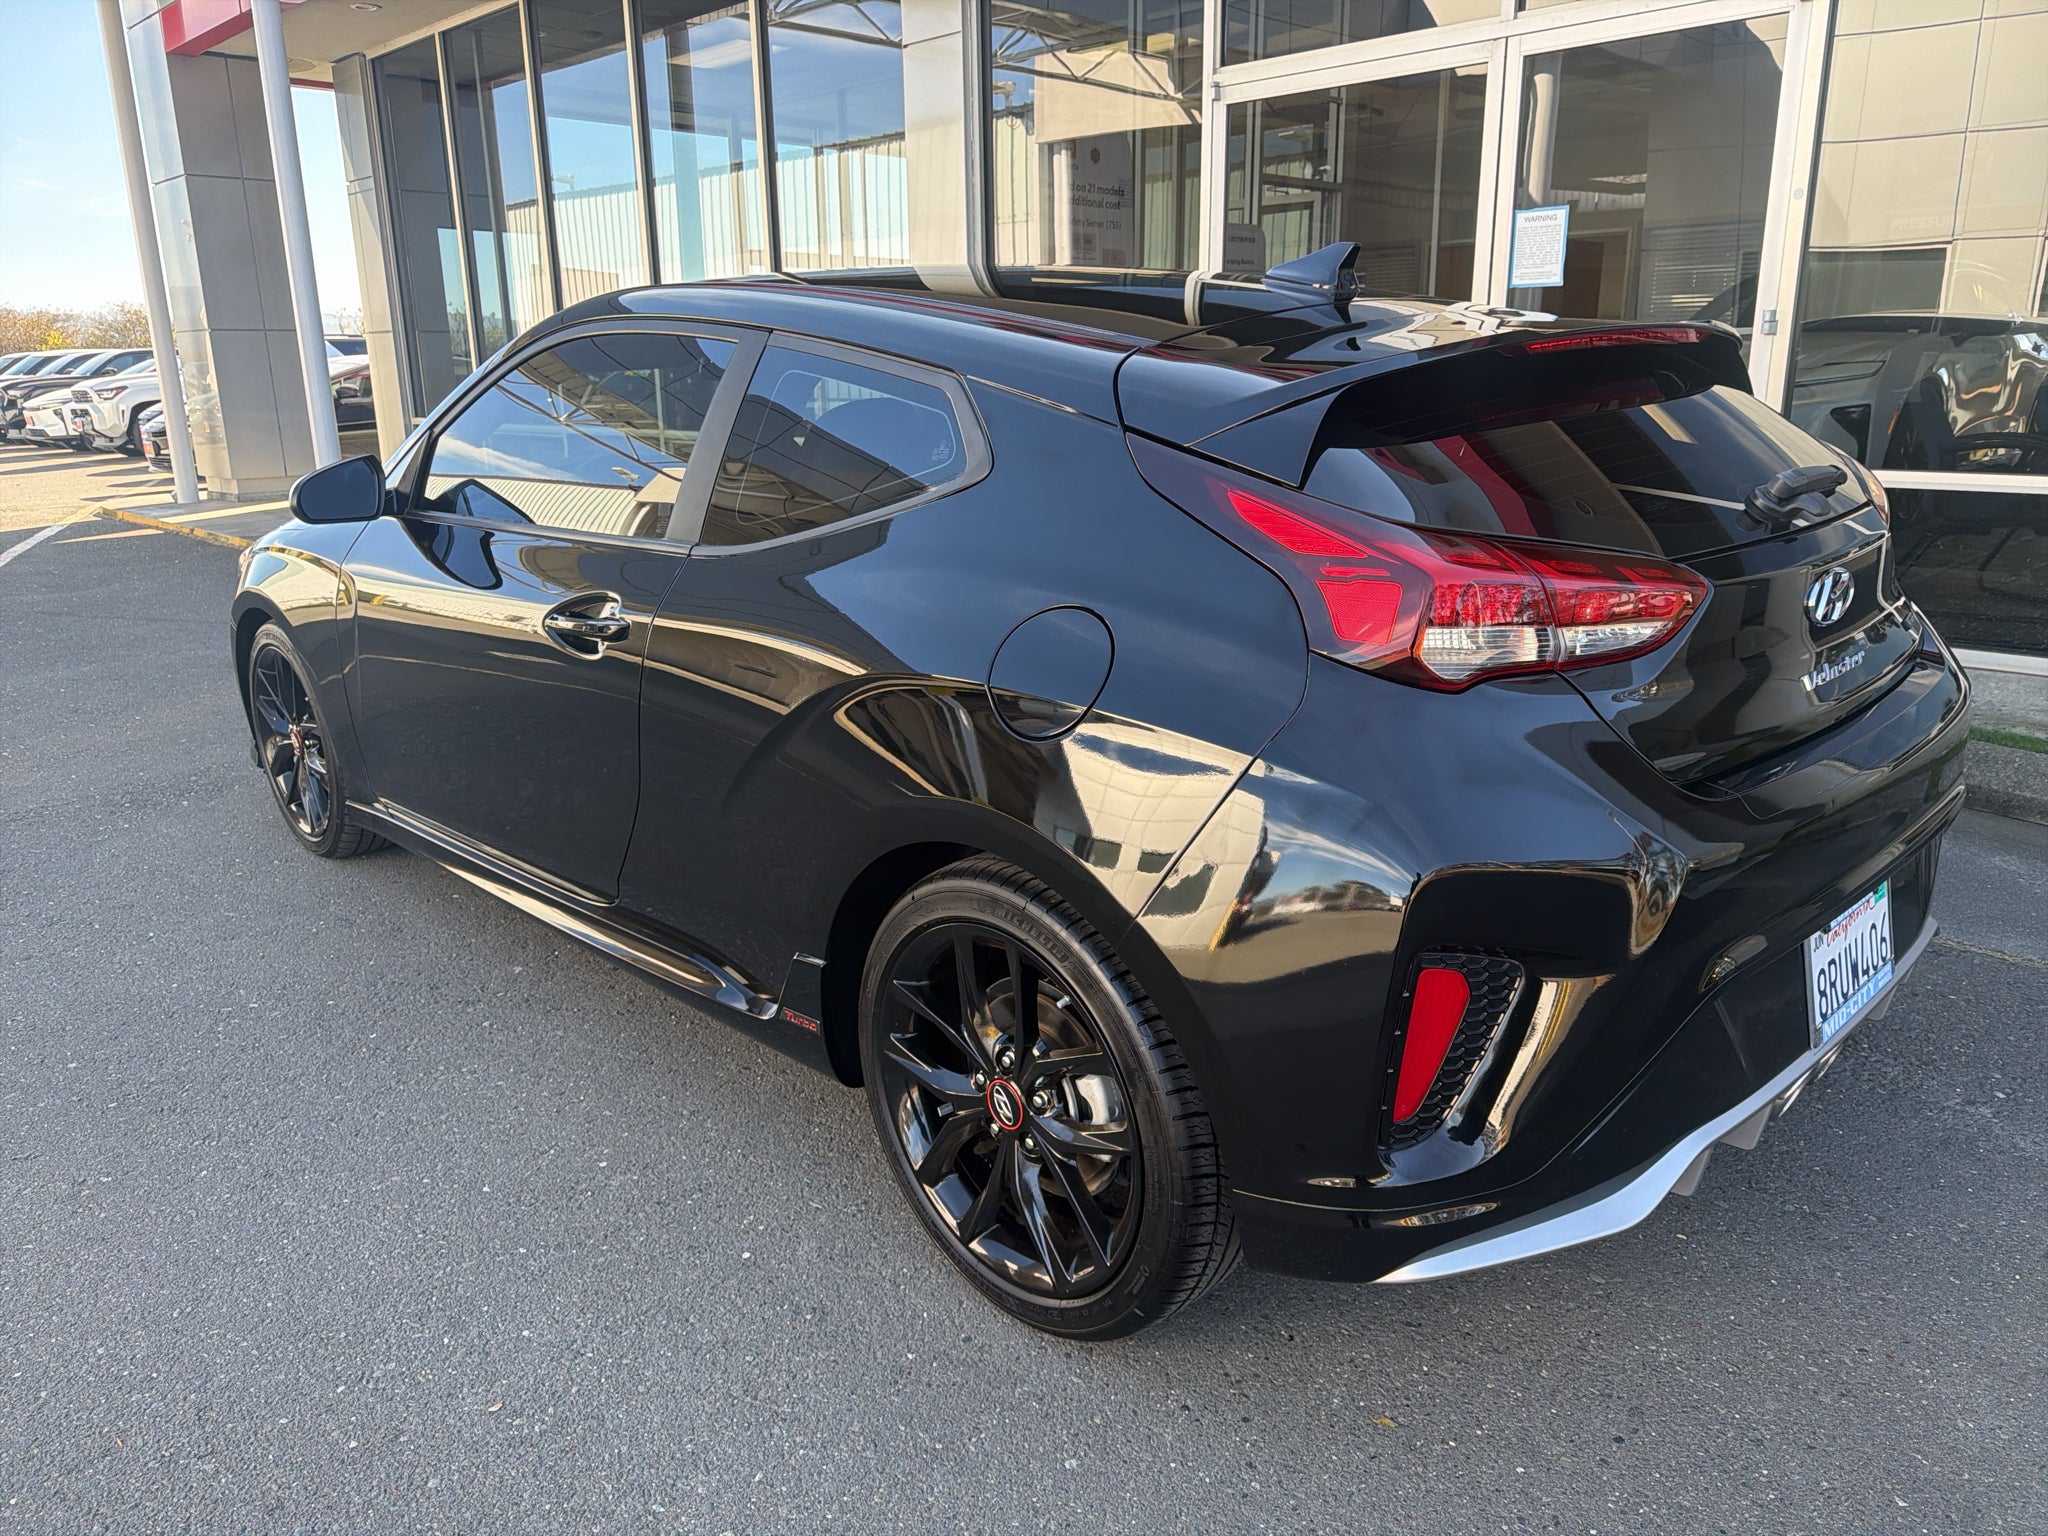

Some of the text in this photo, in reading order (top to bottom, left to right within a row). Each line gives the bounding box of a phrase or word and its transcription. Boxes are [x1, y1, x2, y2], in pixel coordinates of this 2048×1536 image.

[1076, 184, 1086, 193] on
[1087, 183, 1096, 194] 21
[1097, 185, 1124, 197] models
[1071, 194, 1120, 211] dditional cost
[1524, 214, 1558, 223] WARNING
[1800, 650, 1865, 692] Veloster
[994, 905, 1069, 963] MICHELIN
[1814, 933, 1824, 952] JUN
[1817, 912, 1889, 1022] 8RUW406
[783, 1009, 817, 1031] Turbo
[1823, 980, 1875, 1042] MID-CITY
